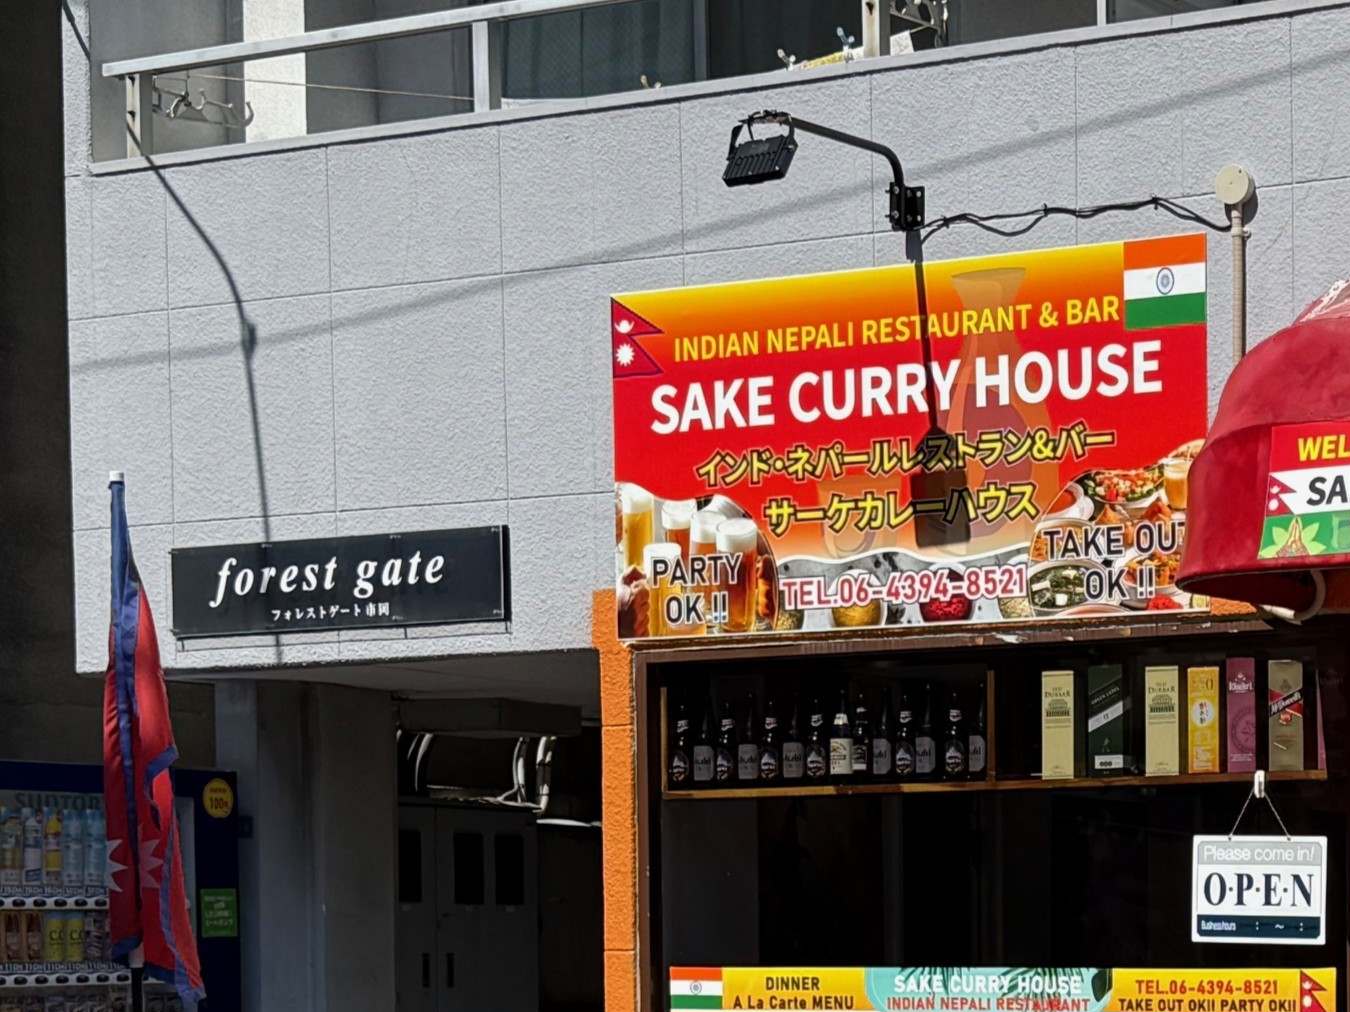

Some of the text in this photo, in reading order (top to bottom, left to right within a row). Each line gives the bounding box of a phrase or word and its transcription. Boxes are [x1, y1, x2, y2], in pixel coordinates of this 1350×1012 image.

[674, 295, 1119, 362] INDIAN NEPALI RESTAURANT & BAR
[651, 340, 1163, 434] SAKE CURRY HOUSE
[698, 421, 1115, 487] インド・ネパールレストラン&バー
[765, 483, 1040, 537] サーケカレーハウス
[1043, 524, 1124, 560] TAKE
[209, 551, 446, 608] forest gate
[652, 553, 742, 588] PARTY
[1085, 567, 1128, 600] OK
[664, 594, 699, 626] OK
[1203, 846, 1315, 861] Please come in!
[765, 976, 820, 991] DINNER
[894, 975, 1082, 994] SAKE CURRY HOUSE
[733, 995, 854, 1010] A La Carte MENU
[887, 996, 1090, 1012] INDIAN NEPALI RESTAURANT
[1120, 998, 1153, 1012] TAKE
[1158, 999, 1184, 1012] OUT
[1220, 999, 1265, 1012] PARTY
